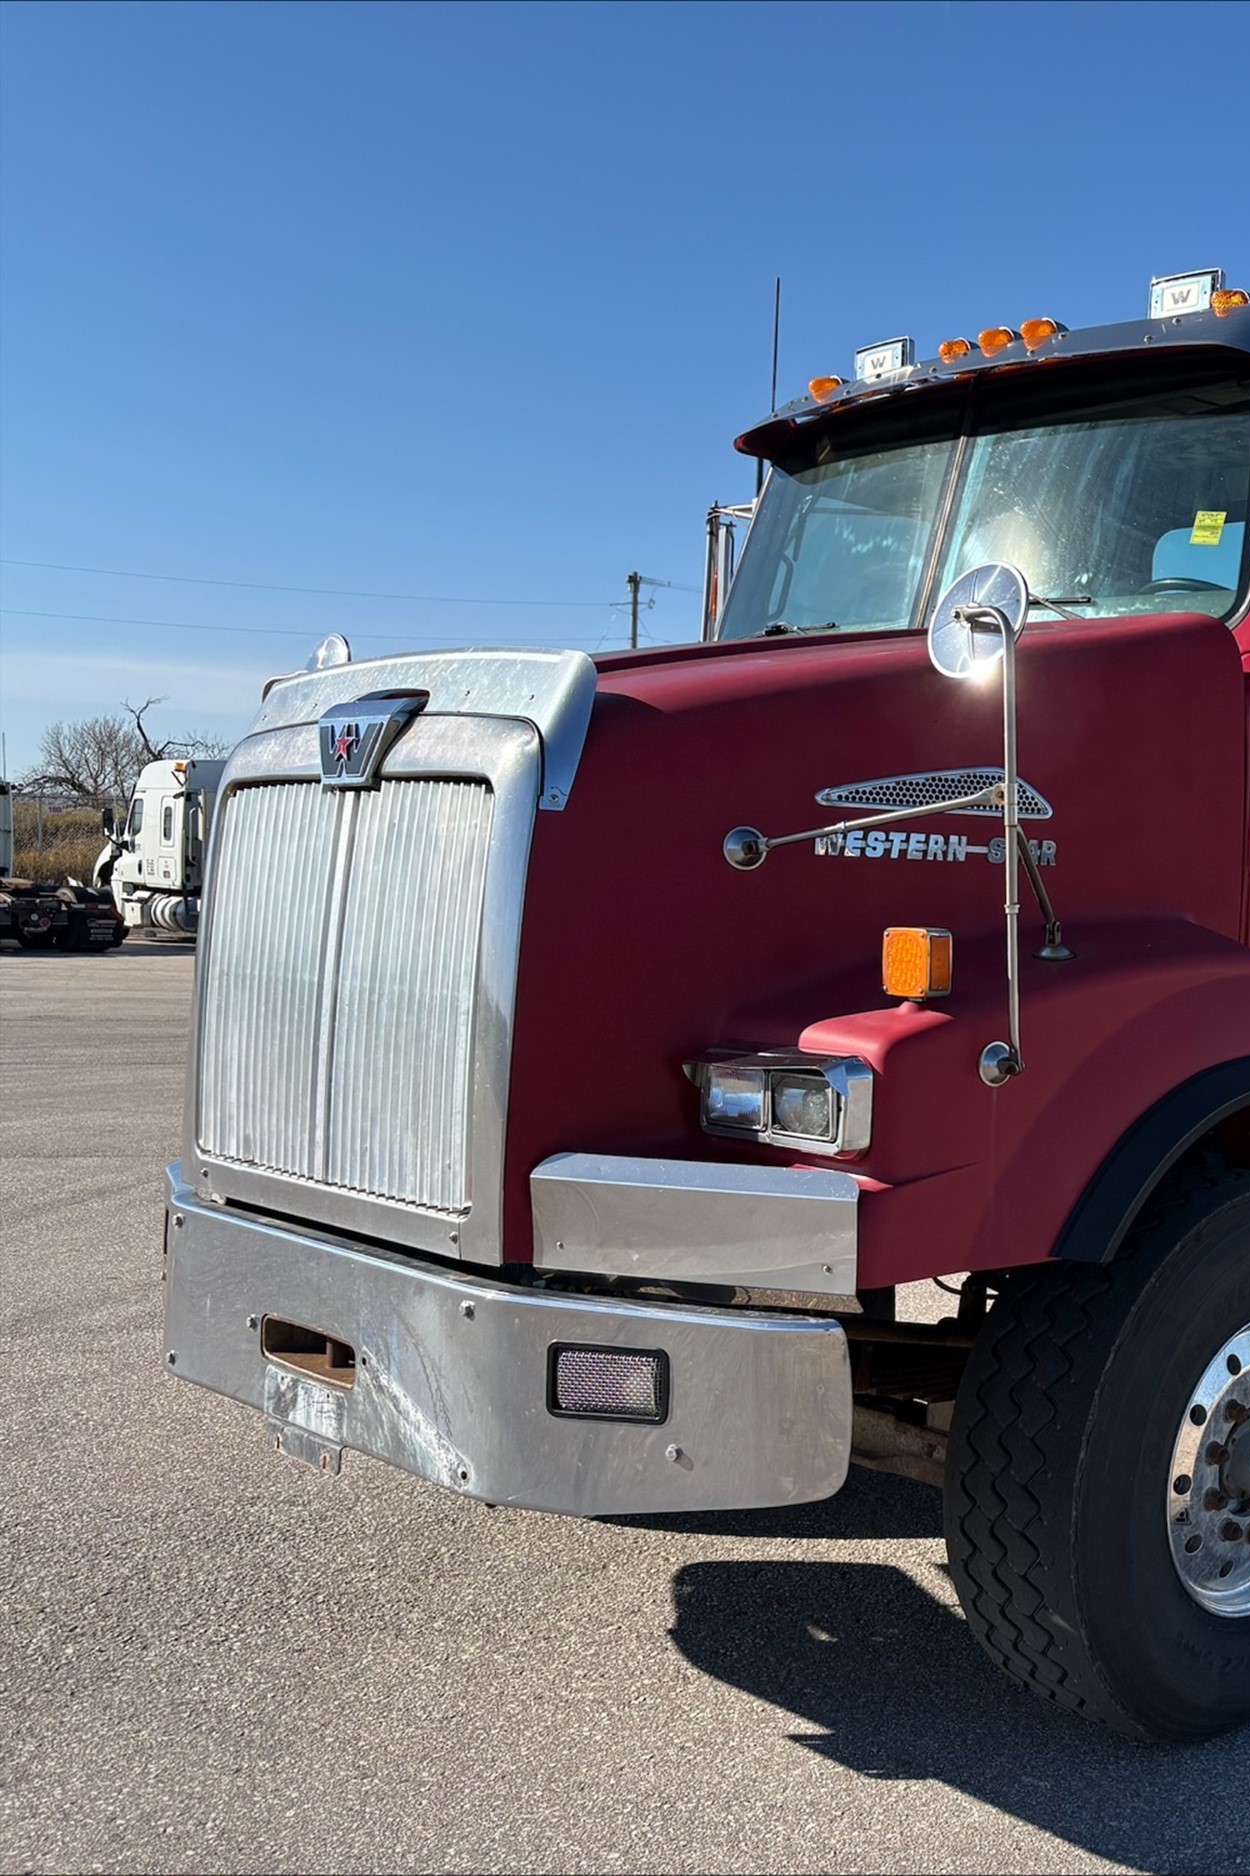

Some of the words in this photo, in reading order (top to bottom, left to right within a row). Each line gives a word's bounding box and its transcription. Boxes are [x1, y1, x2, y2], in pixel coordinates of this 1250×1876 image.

[1170, 288, 1192, 305] W
[871, 355, 886, 370] W
[814, 831, 968, 862] WESTERN
[987, 837, 1057, 866] SAR
